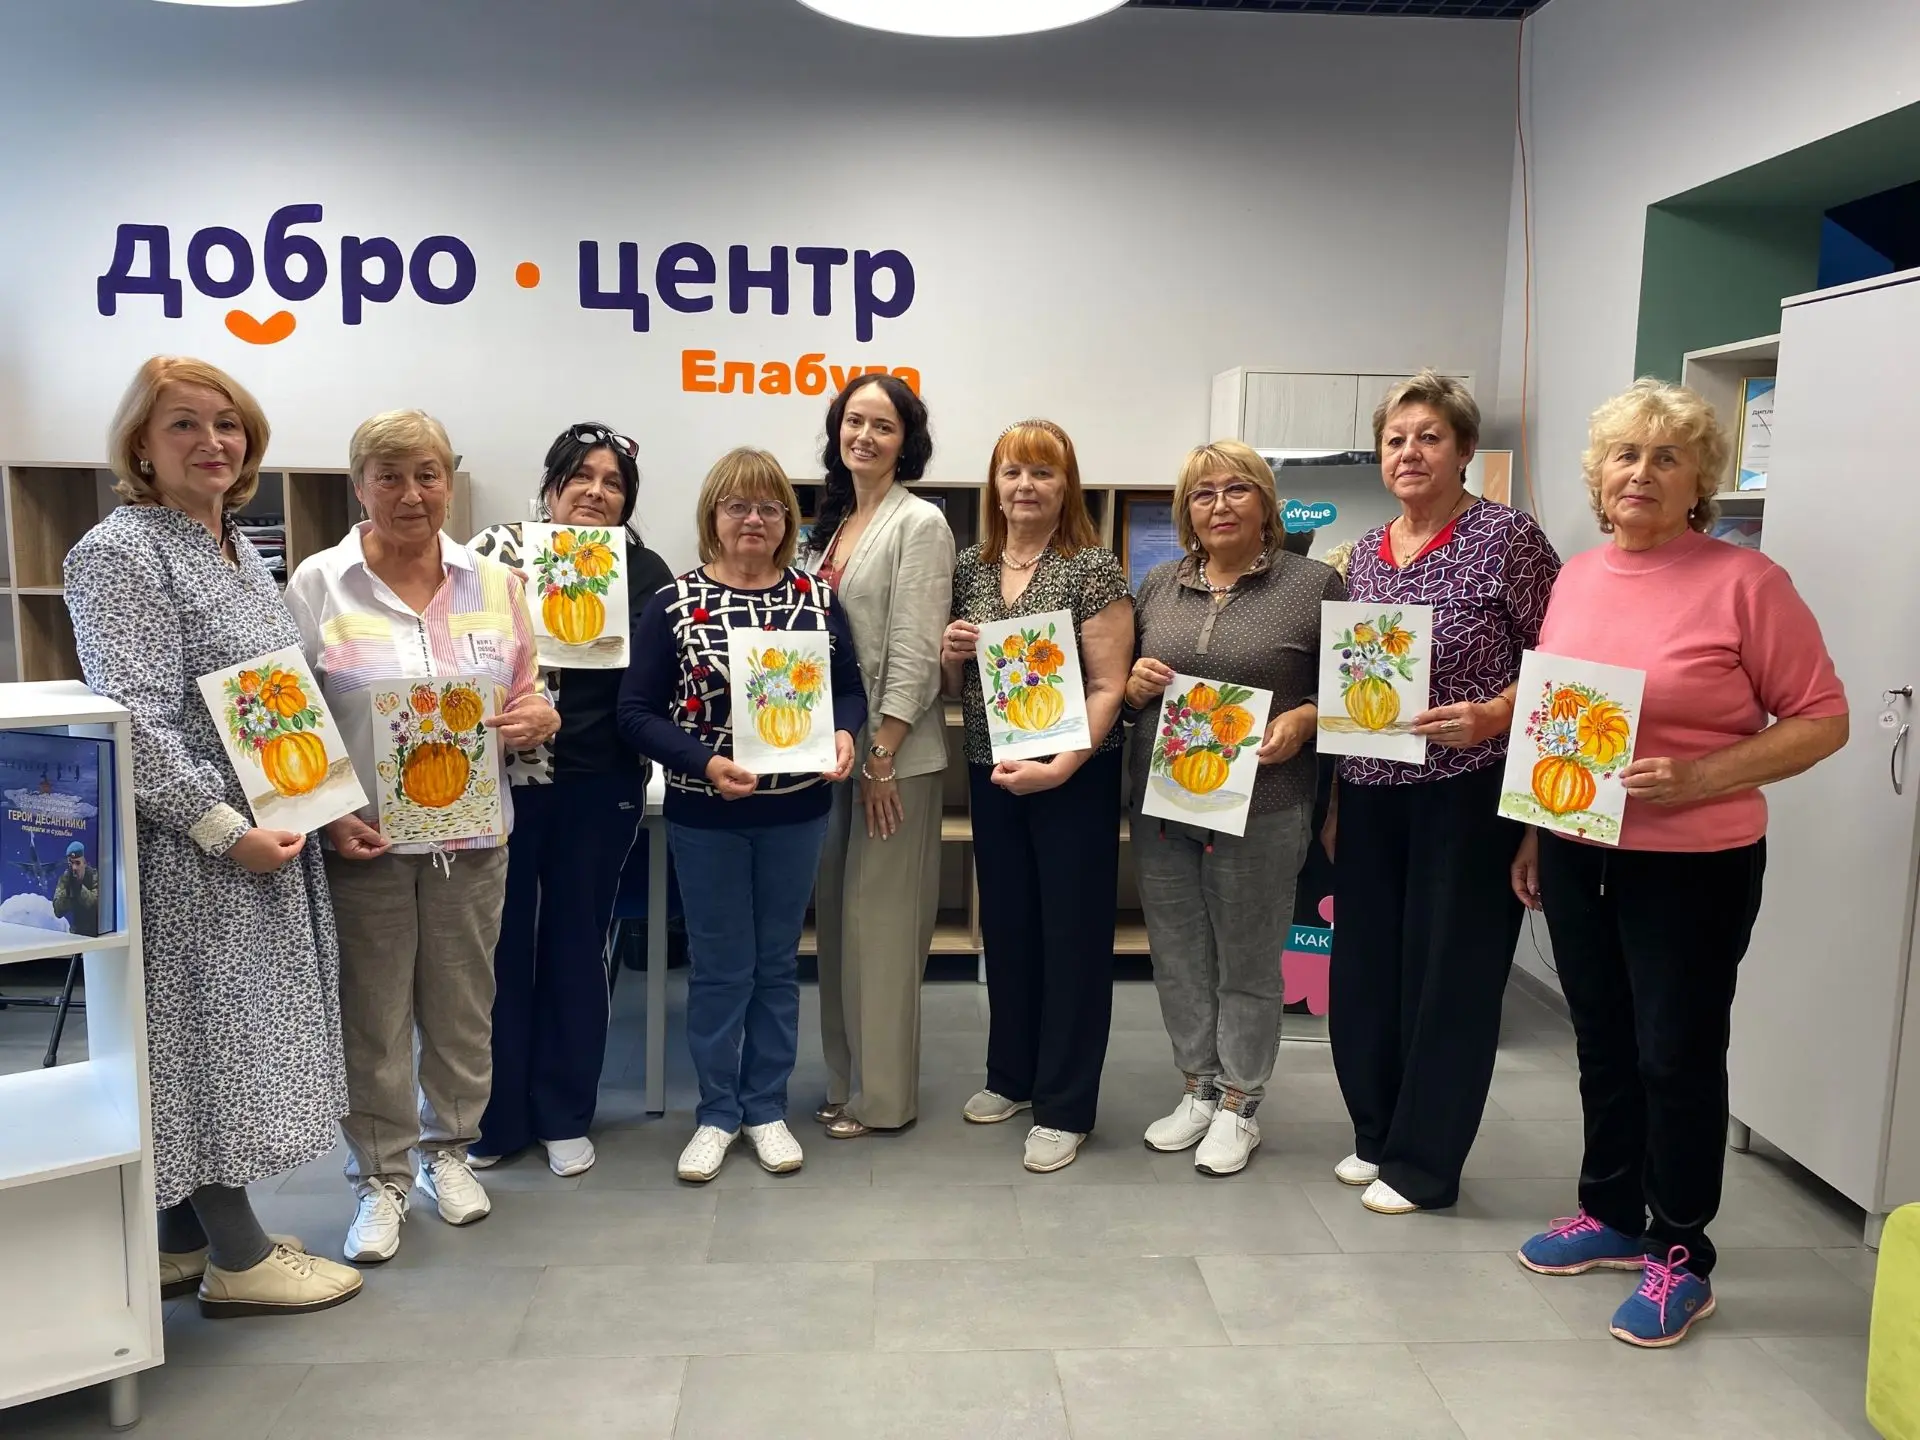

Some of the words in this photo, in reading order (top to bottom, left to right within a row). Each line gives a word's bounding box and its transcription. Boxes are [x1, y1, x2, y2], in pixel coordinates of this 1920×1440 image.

[97, 203, 477, 326] добро
[579, 240, 916, 342] центр
[35, 813, 87, 830] ДЕСАНТНИКИ
[1294, 932, 1330, 948] КАК
